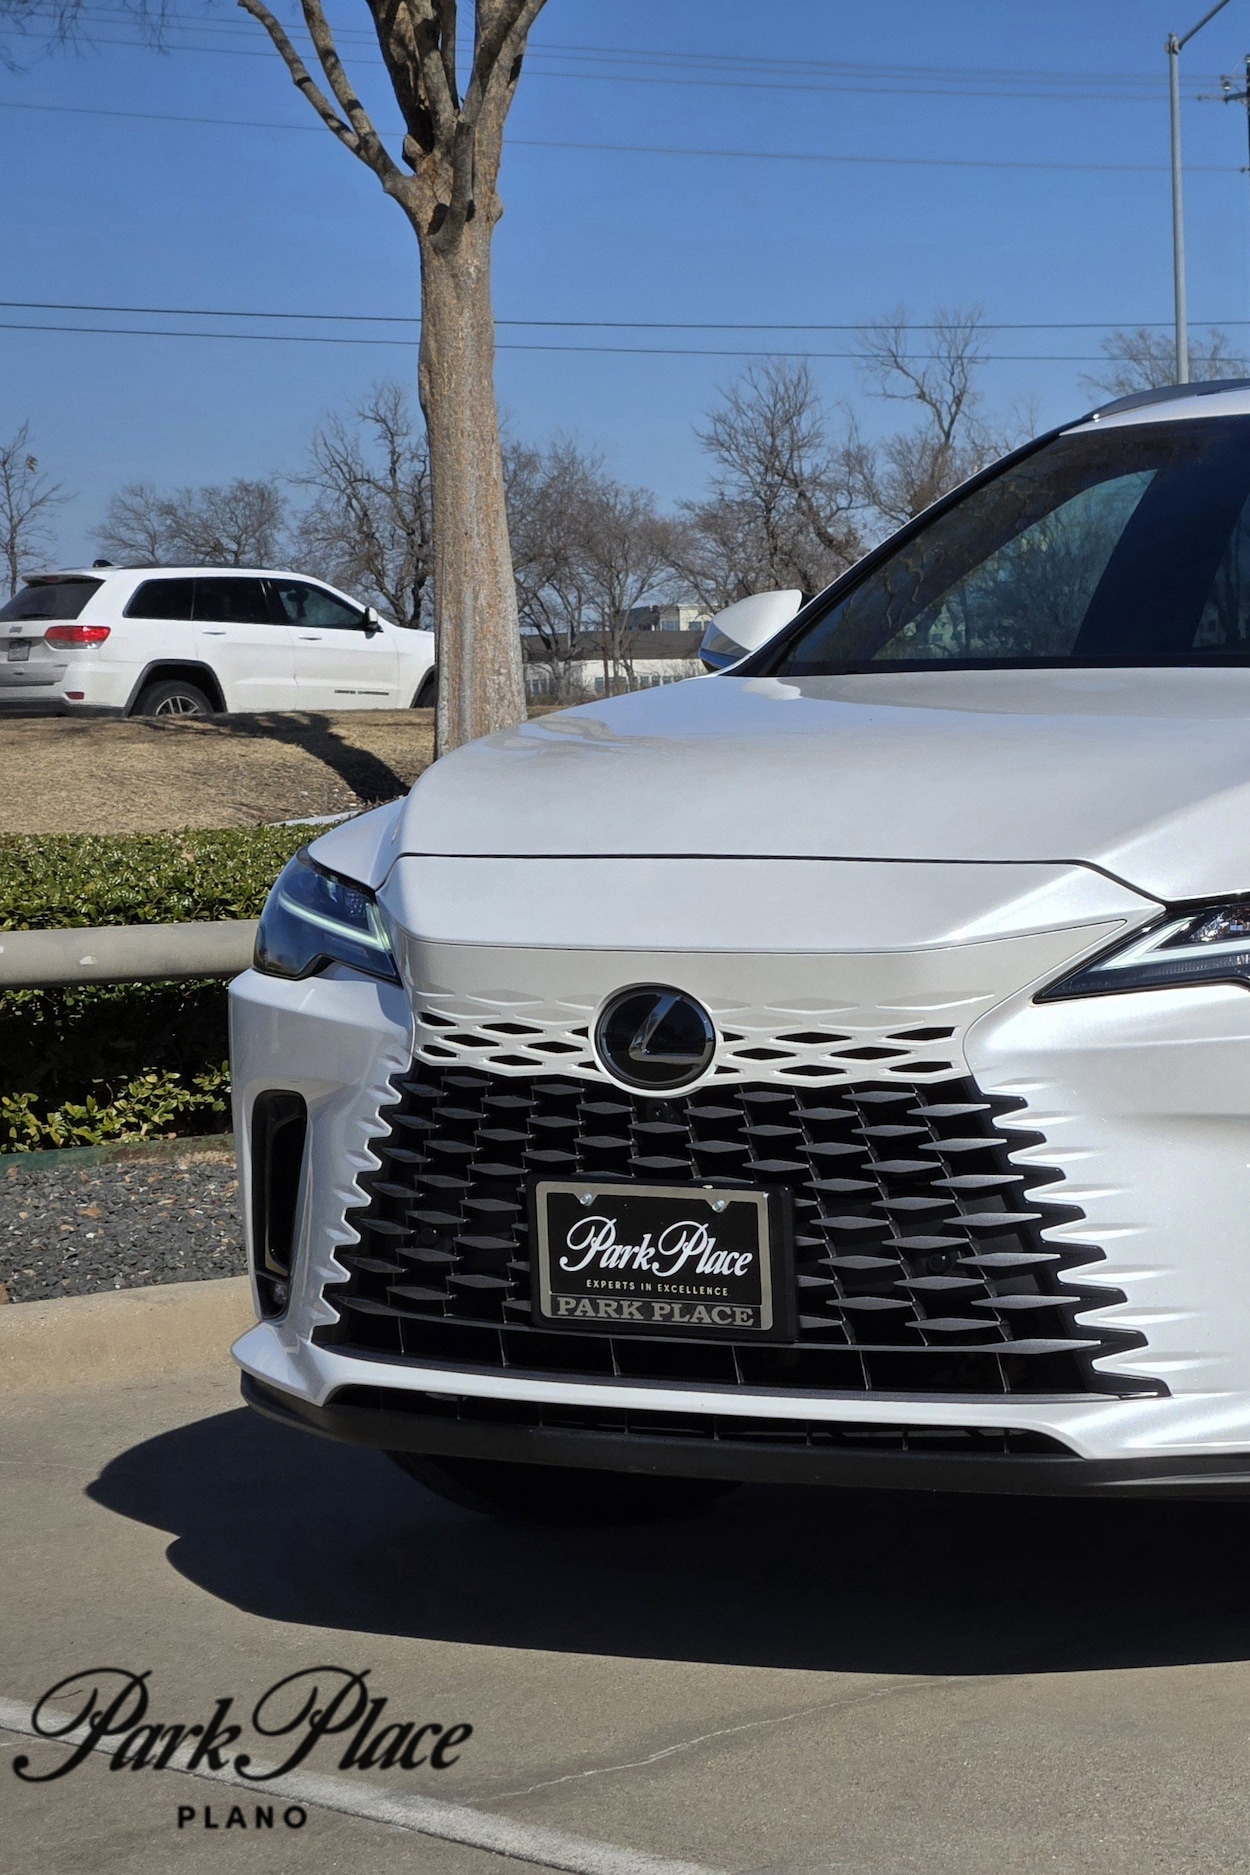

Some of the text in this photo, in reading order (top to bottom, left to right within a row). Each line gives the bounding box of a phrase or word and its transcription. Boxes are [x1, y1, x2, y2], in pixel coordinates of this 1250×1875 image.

[559, 1215, 753, 1277] Park Place
[586, 1279, 729, 1297] EXPERTS IN EXCELLENCE
[557, 1297, 754, 1326] PARK PLACE
